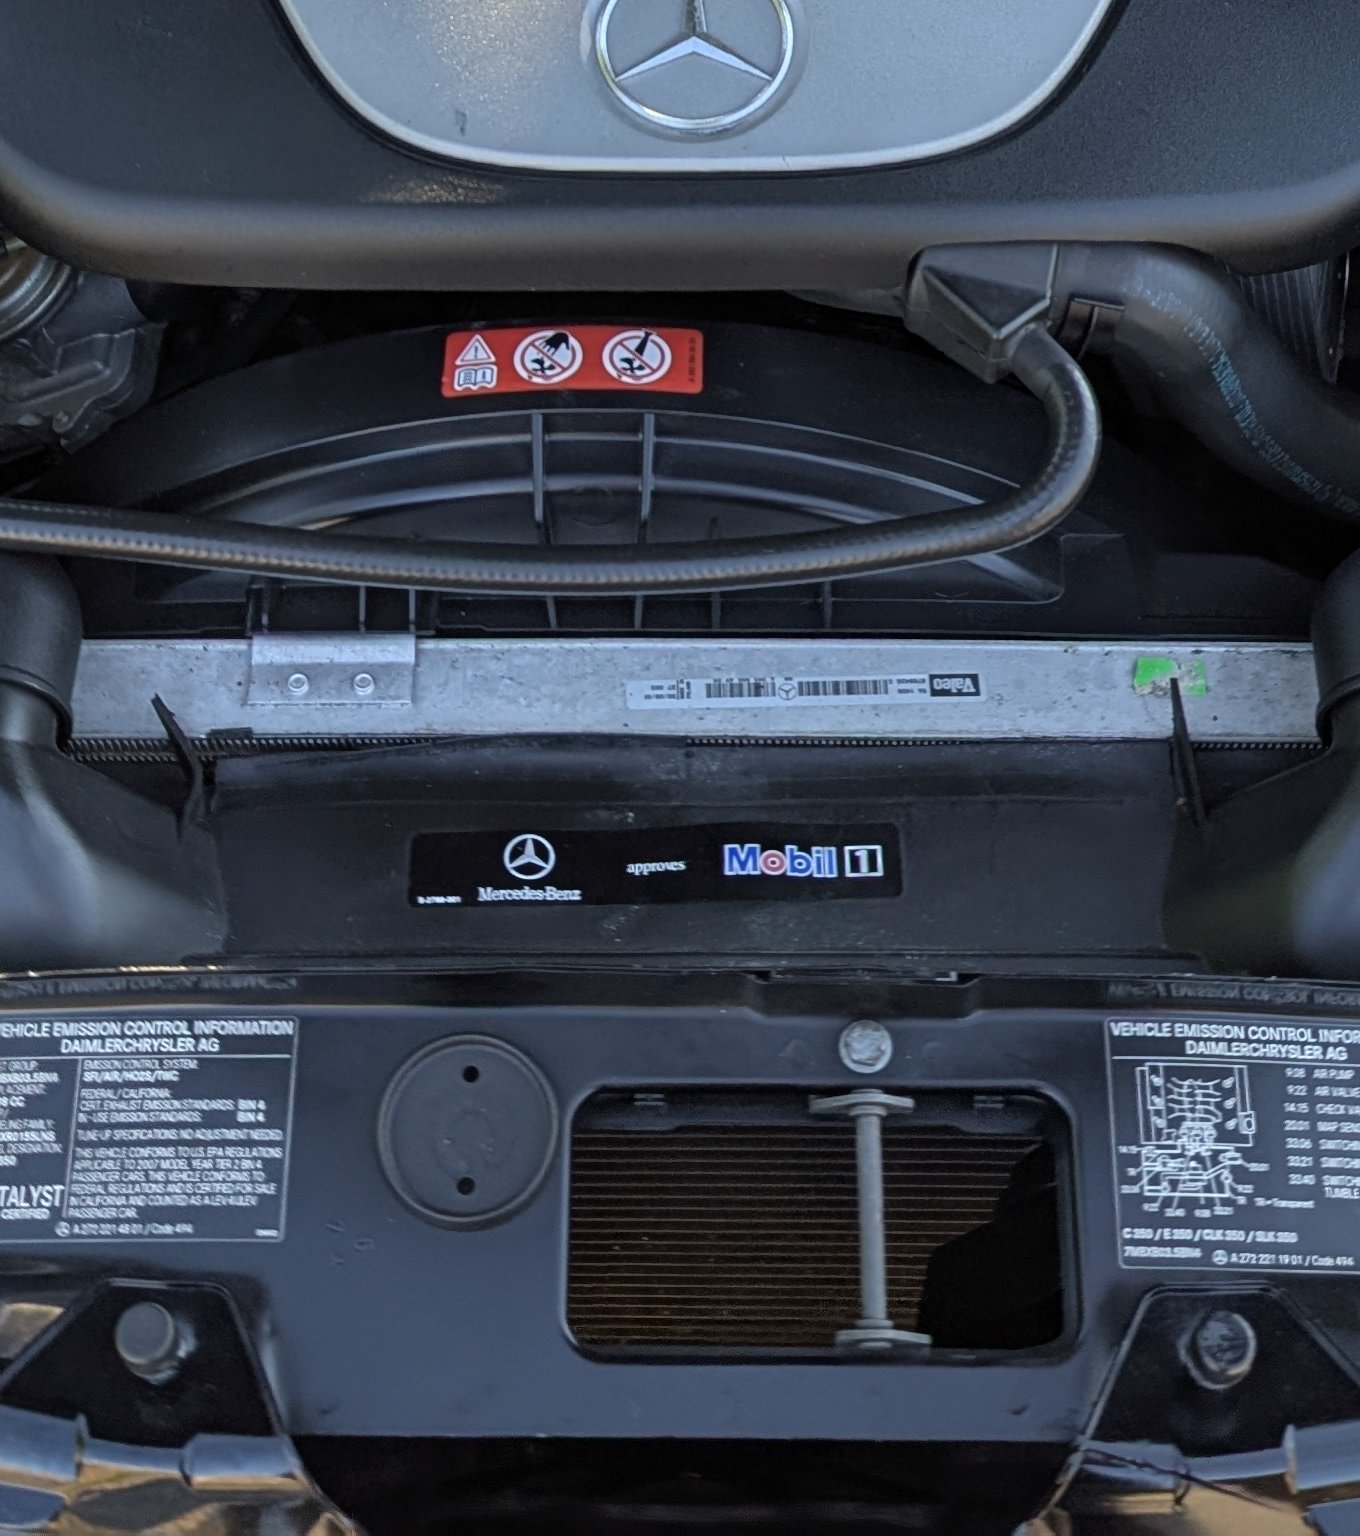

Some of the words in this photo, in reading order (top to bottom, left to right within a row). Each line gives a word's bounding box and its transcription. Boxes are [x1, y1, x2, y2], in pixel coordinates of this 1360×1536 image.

[932, 677, 977, 693] Valeo
[626, 859, 687, 875] approves
[722, 843, 838, 878] Mobil
[476, 885, 583, 902] Mercedes-Benz
[52, 1020, 122, 1037] EMISSION
[123, 1020, 192, 1037] CONTROL
[193, 1019, 295, 1036] INFORMATION
[1108, 1021, 1173, 1038] VEHICLE
[1173, 1022, 1245, 1040] EMISSION
[1247, 1025, 1318, 1043] CONTROL
[60, 1037, 196, 1054] DAIMLERCHRYSLER
[196, 1037, 221, 1053] AG
[1184, 1040, 1324, 1061] DAIMLERCHRYSLER
[1325, 1046, 1349, 1062] AG
